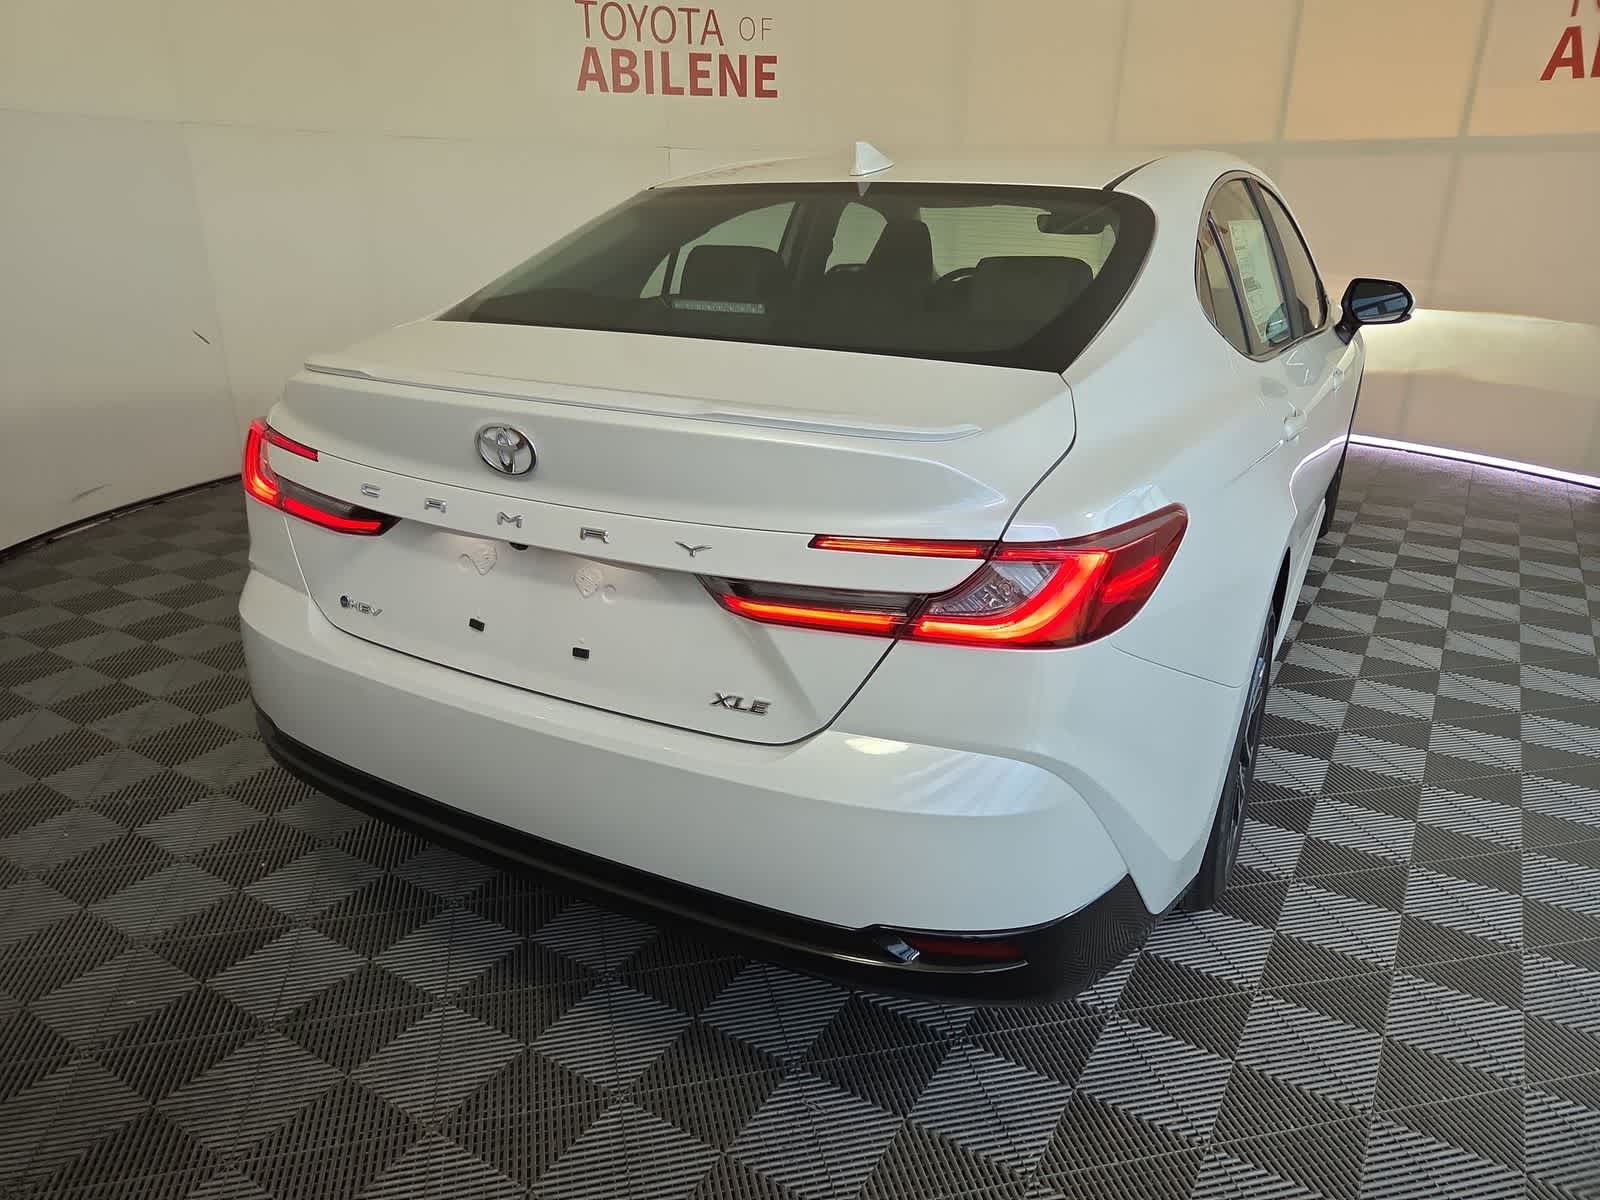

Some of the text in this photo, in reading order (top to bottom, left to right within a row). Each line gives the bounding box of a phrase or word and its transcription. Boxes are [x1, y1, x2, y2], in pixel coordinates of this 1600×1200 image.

[575, 0, 773, 46] TOYOTA OF
[576, 46, 778, 98] ABILENE
[1539, 26, 1600, 81] A
[360, 482, 713, 557] CAMRY
[710, 692, 772, 716] XLE
